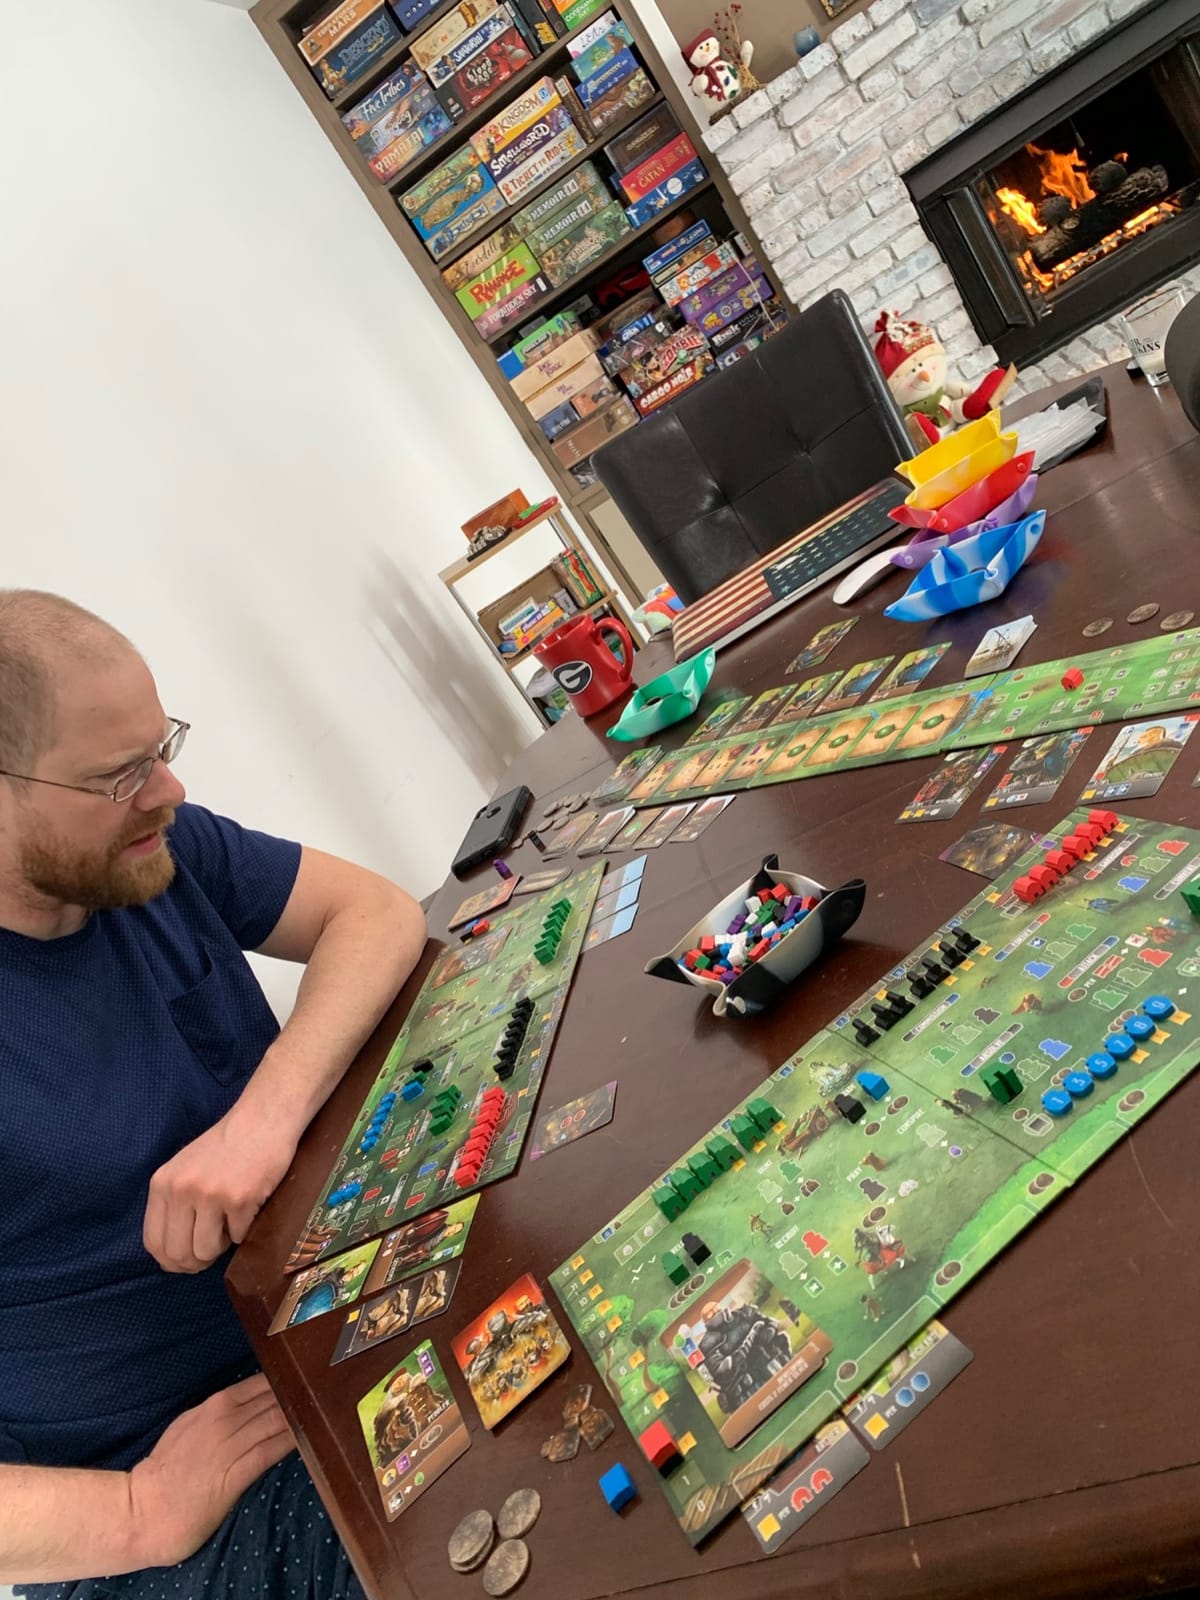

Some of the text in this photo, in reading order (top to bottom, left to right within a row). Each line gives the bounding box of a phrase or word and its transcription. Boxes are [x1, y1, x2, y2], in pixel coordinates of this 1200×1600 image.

[328, 8, 357, 37] MARS
[498, 93, 541, 133] KINGDOM
[375, 127, 425, 173] YAMATAI
[509, 163, 540, 190] TICKET
[544, 142, 566, 161] RIDE
[638, 164, 665, 188] CATAN
[530, 190, 566, 221] MEMOIR
[543, 211, 579, 242] MEMOIR
[523, 286, 538, 302] SKY
[640, 382, 671, 408] CARGO
[554, 662, 591, 693] G
